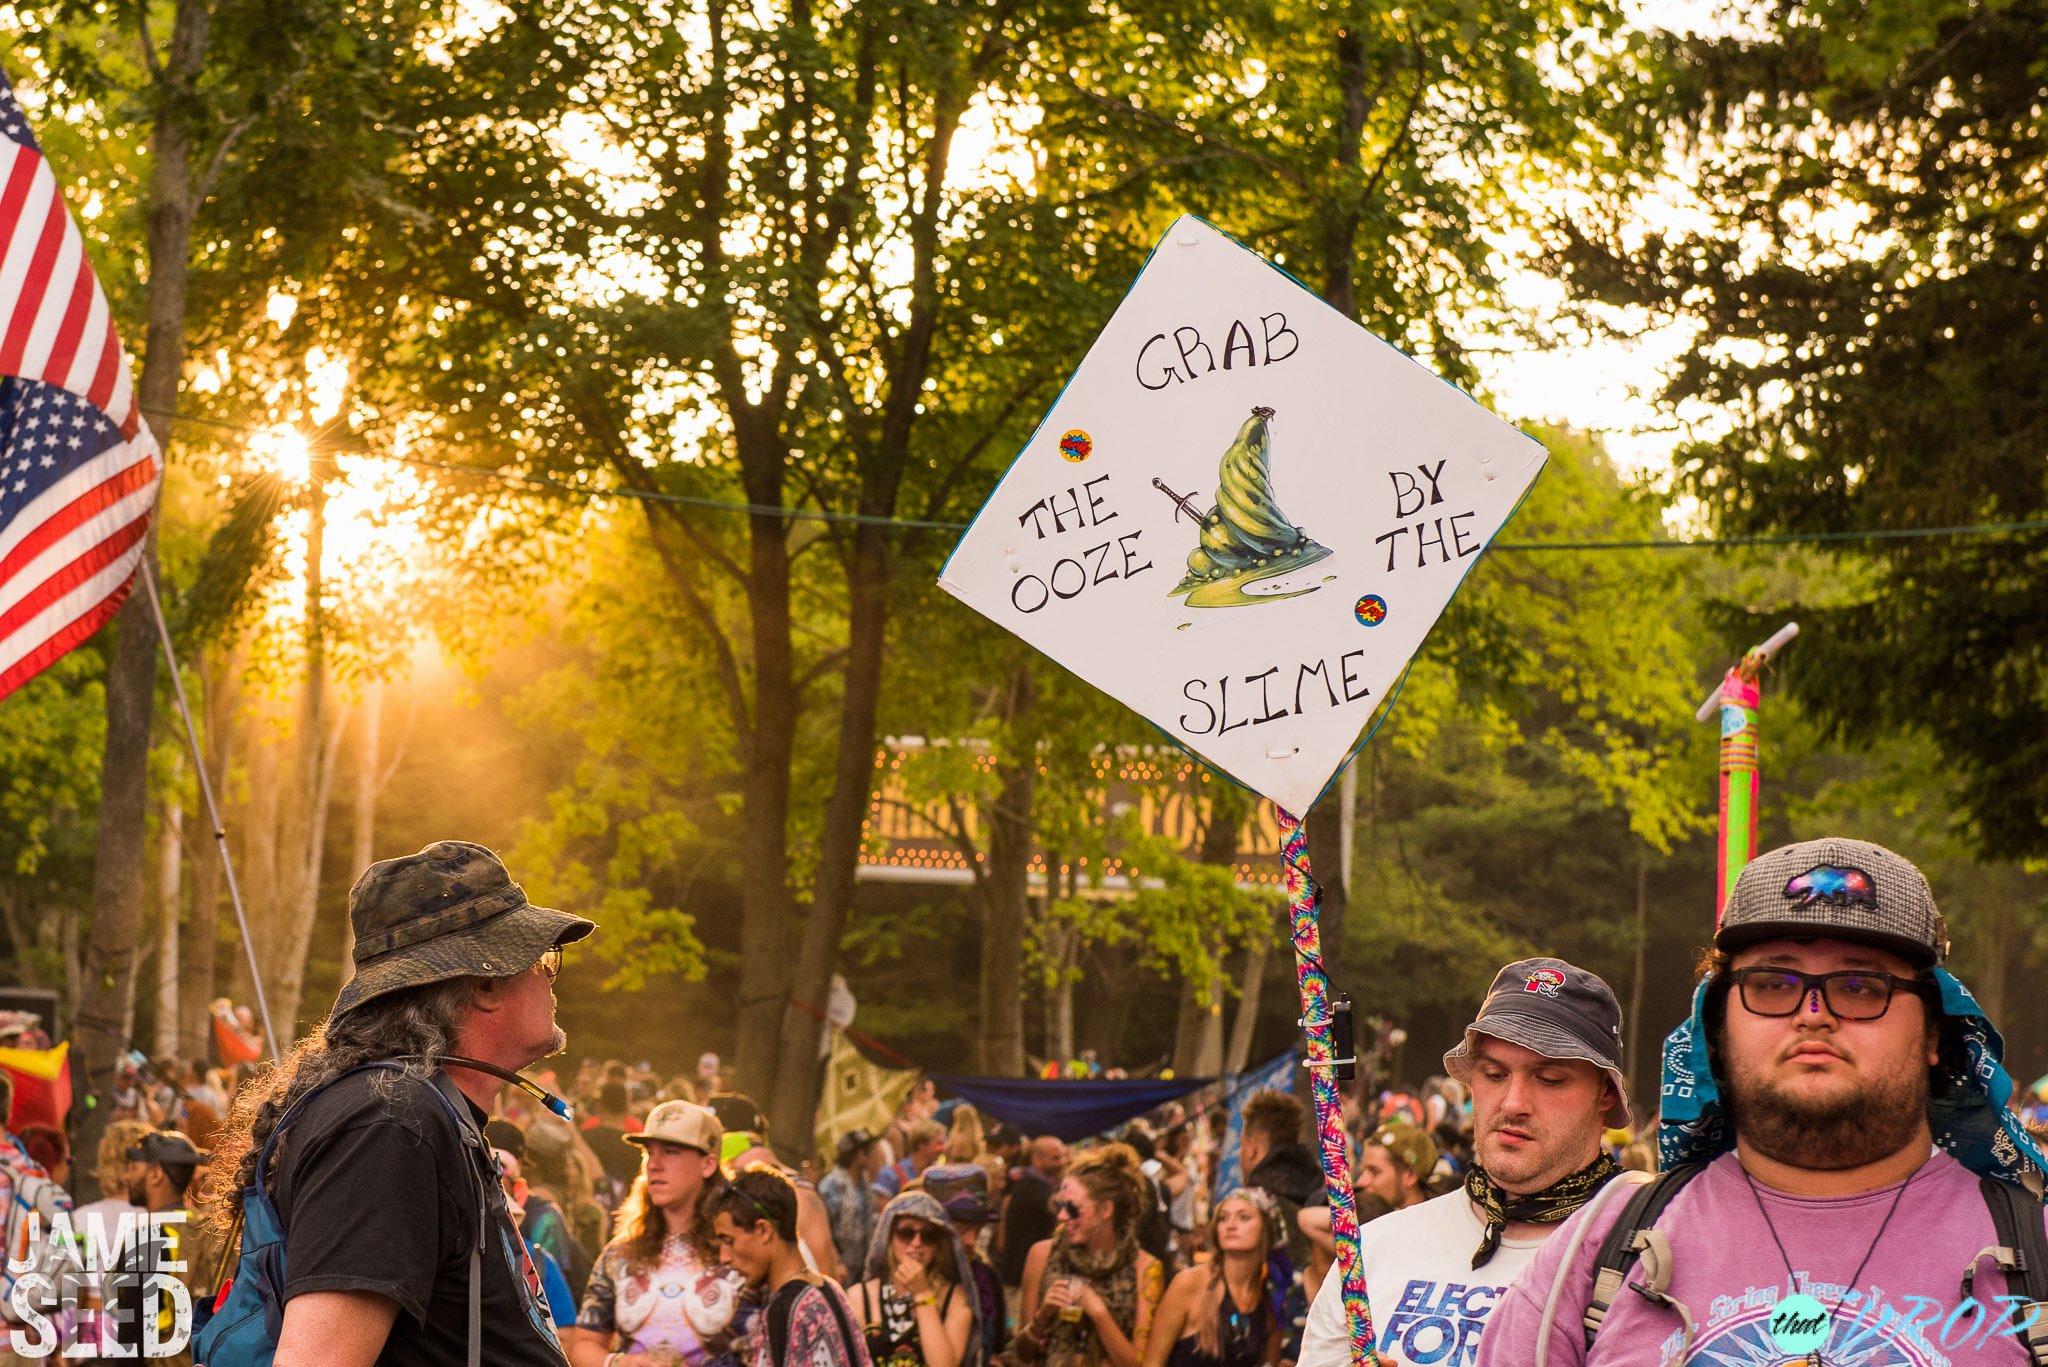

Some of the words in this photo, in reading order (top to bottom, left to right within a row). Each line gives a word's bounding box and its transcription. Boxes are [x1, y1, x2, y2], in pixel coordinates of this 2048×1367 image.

[1136, 312, 1299, 391] GRAB
[1018, 473, 1119, 540] THE
[1388, 459, 1447, 519] BY
[1011, 530, 1154, 614] OOZE
[1375, 510, 1481, 573] THE
[1179, 649, 1370, 737] SLIME
[1707, 1285, 1778, 1327] String
